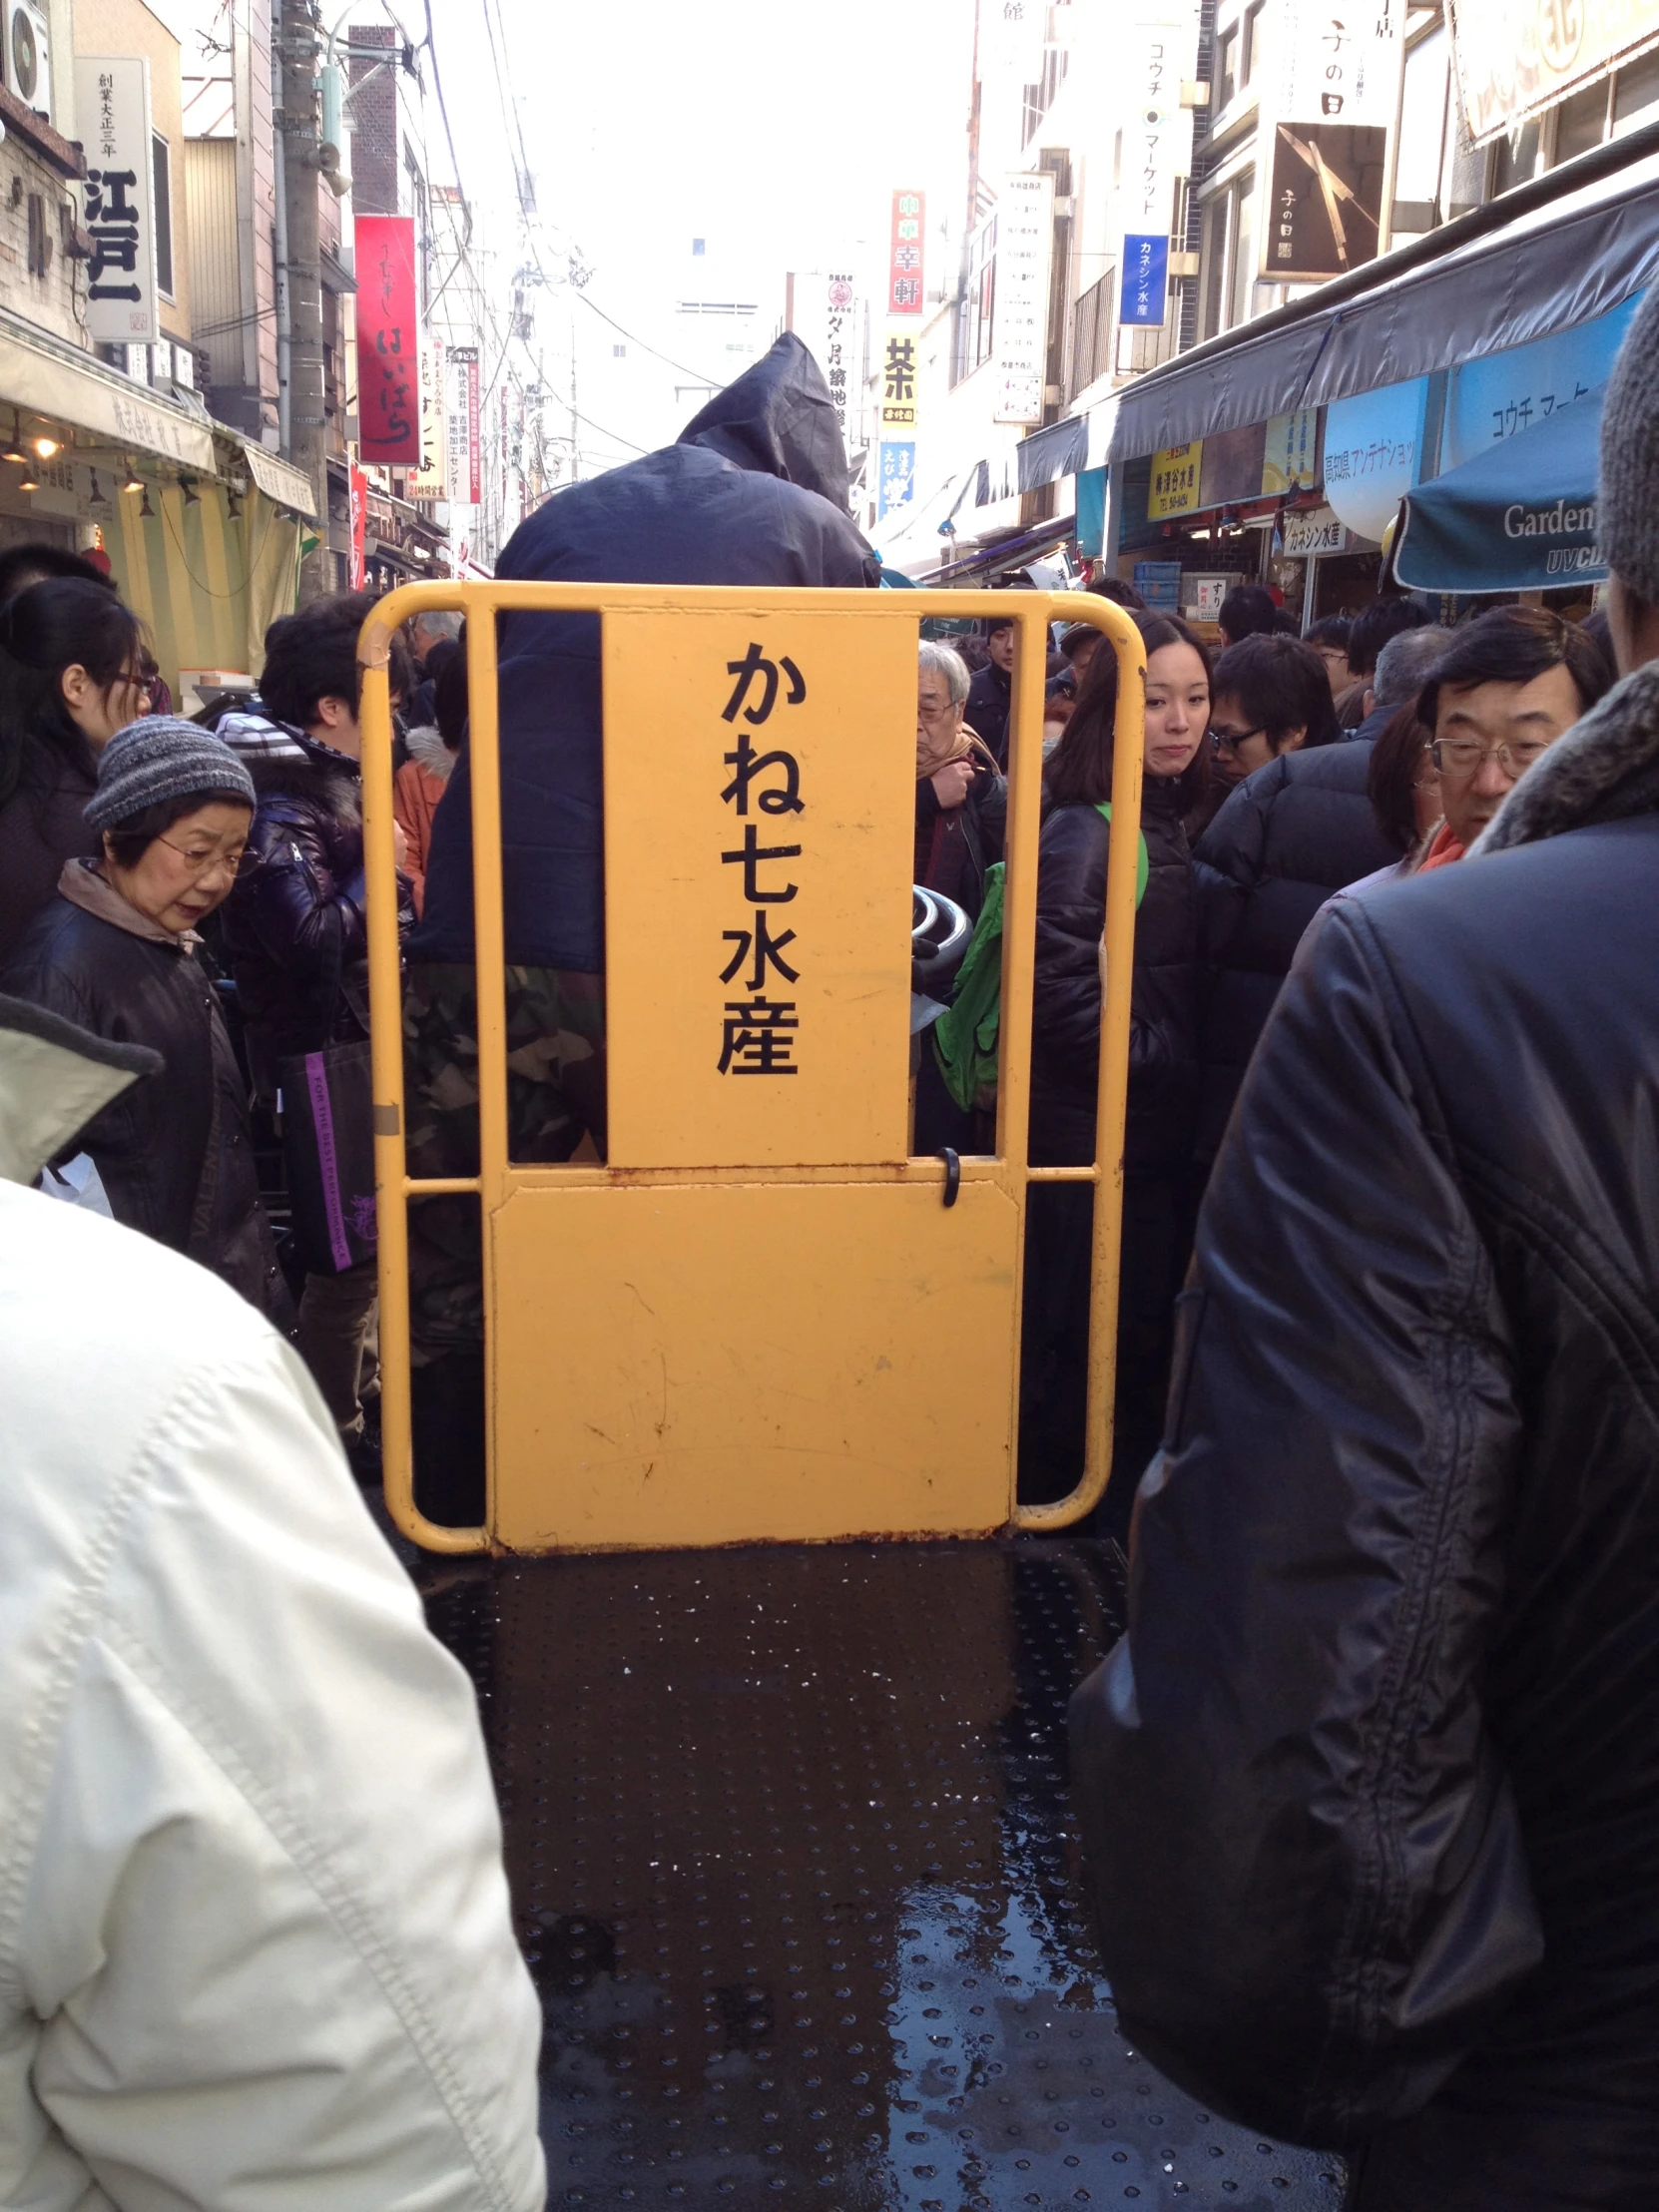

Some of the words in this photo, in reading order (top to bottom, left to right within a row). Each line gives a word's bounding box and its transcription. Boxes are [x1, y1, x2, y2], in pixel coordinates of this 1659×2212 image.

[1149, 45, 1164, 96] コウチ
[99, 73, 117, 159] 創業大正三年
[1144, 135, 1159, 216] マーケット
[84, 169, 142, 302] 江戸一
[1136, 242, 1152, 316] カネシン水産
[458, 369, 467, 409] 株式会社
[884, 338, 915, 400] 茶
[1492, 396, 1533, 437] コウチ
[449, 415, 459, 496] 築地加工センター
[1290, 520, 1341, 551] カネシン水産
[1504, 499, 1594, 538] Garden
[1213, 582, 1223, 608] すり
[716, 642, 806, 1075] かね七水産
[313, 1076, 324, 1107] FOR
[318, 1109, 328, 1130] THE
[321, 1132, 332, 1164] BEST
[325, 1165, 346, 1260] PERFORMANCE
